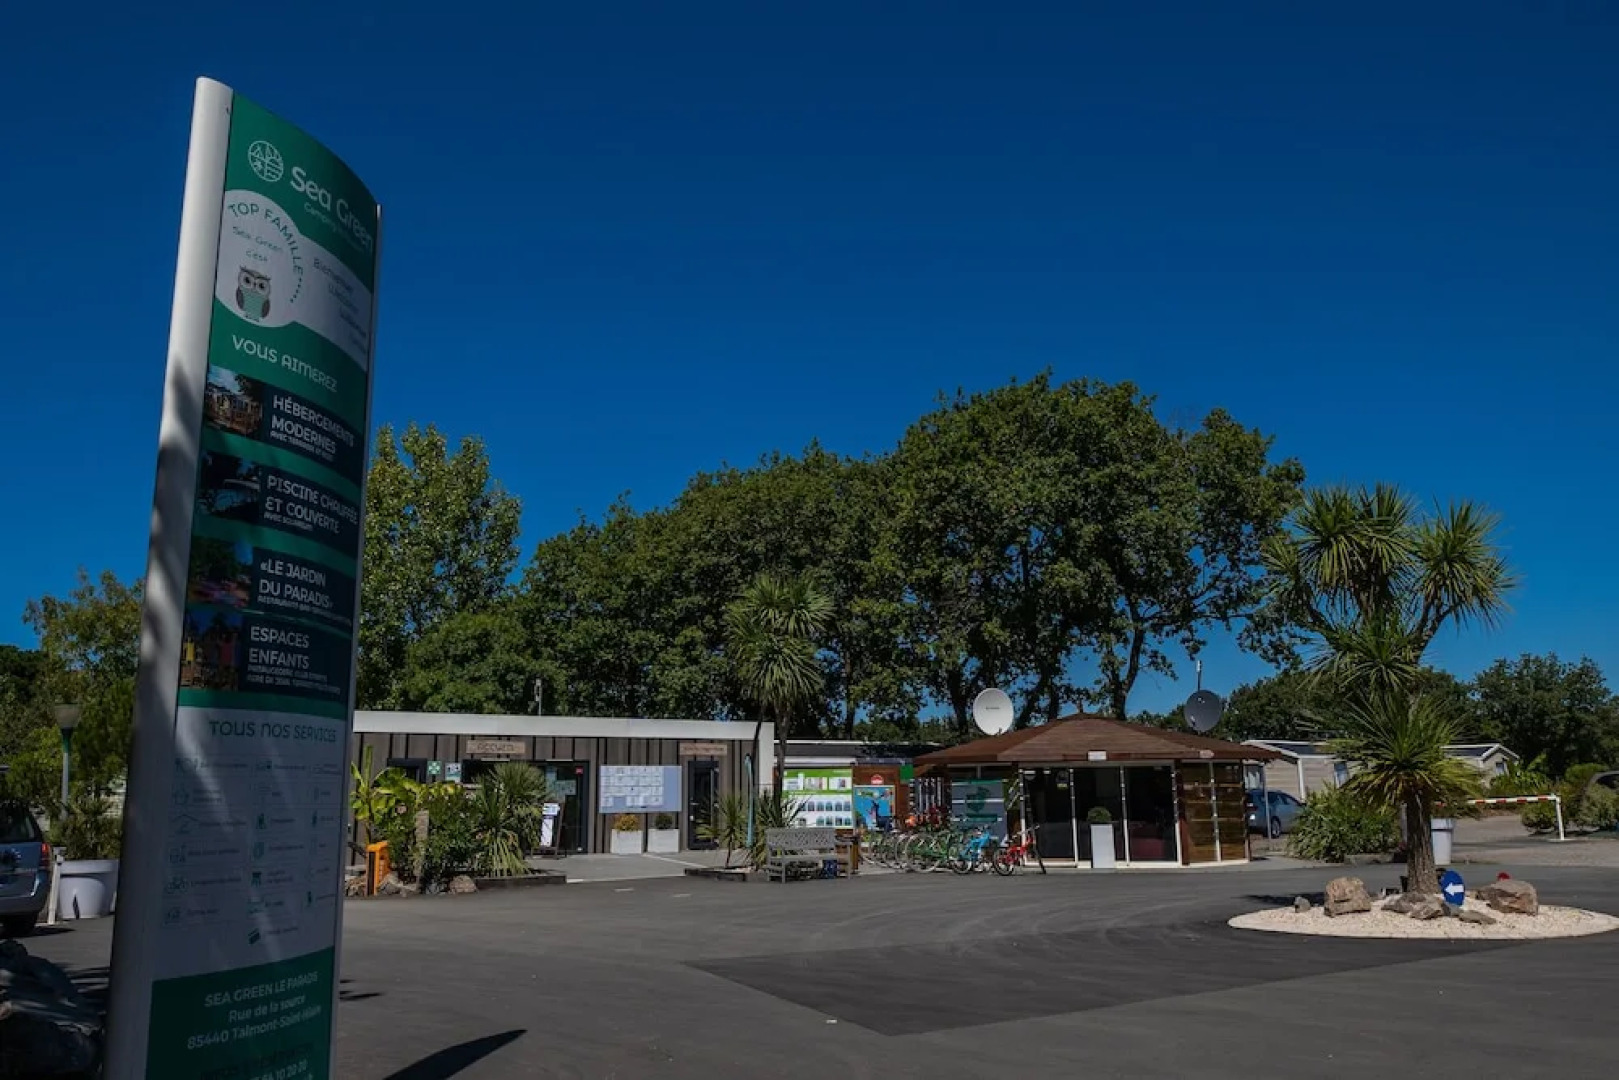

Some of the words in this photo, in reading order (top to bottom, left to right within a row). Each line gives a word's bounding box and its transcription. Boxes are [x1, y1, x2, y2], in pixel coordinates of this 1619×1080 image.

[290, 166, 333, 212] Sea
[227, 202, 260, 218] TOP
[232, 334, 278, 364] VOUS
[271, 414, 336, 455] MODERNES
[266, 475, 319, 505] PISCINE
[265, 496, 283, 513] ET
[286, 502, 340, 534] COUVERTE
[285, 563, 326, 587] JARDIN
[258, 579, 281, 597] DU
[250, 625, 310, 649] ESPACES
[248, 647, 310, 670] ENFANTS
[208, 720, 256, 737] TOUS
[204, 990, 231, 1007] SEA
[234, 984, 273, 1002] GREEN
[274, 979, 286, 993] LE
[229, 1008, 251, 1023] Rue
[253, 1004, 268, 1018] de
[187, 1029, 230, 1050] 85440
